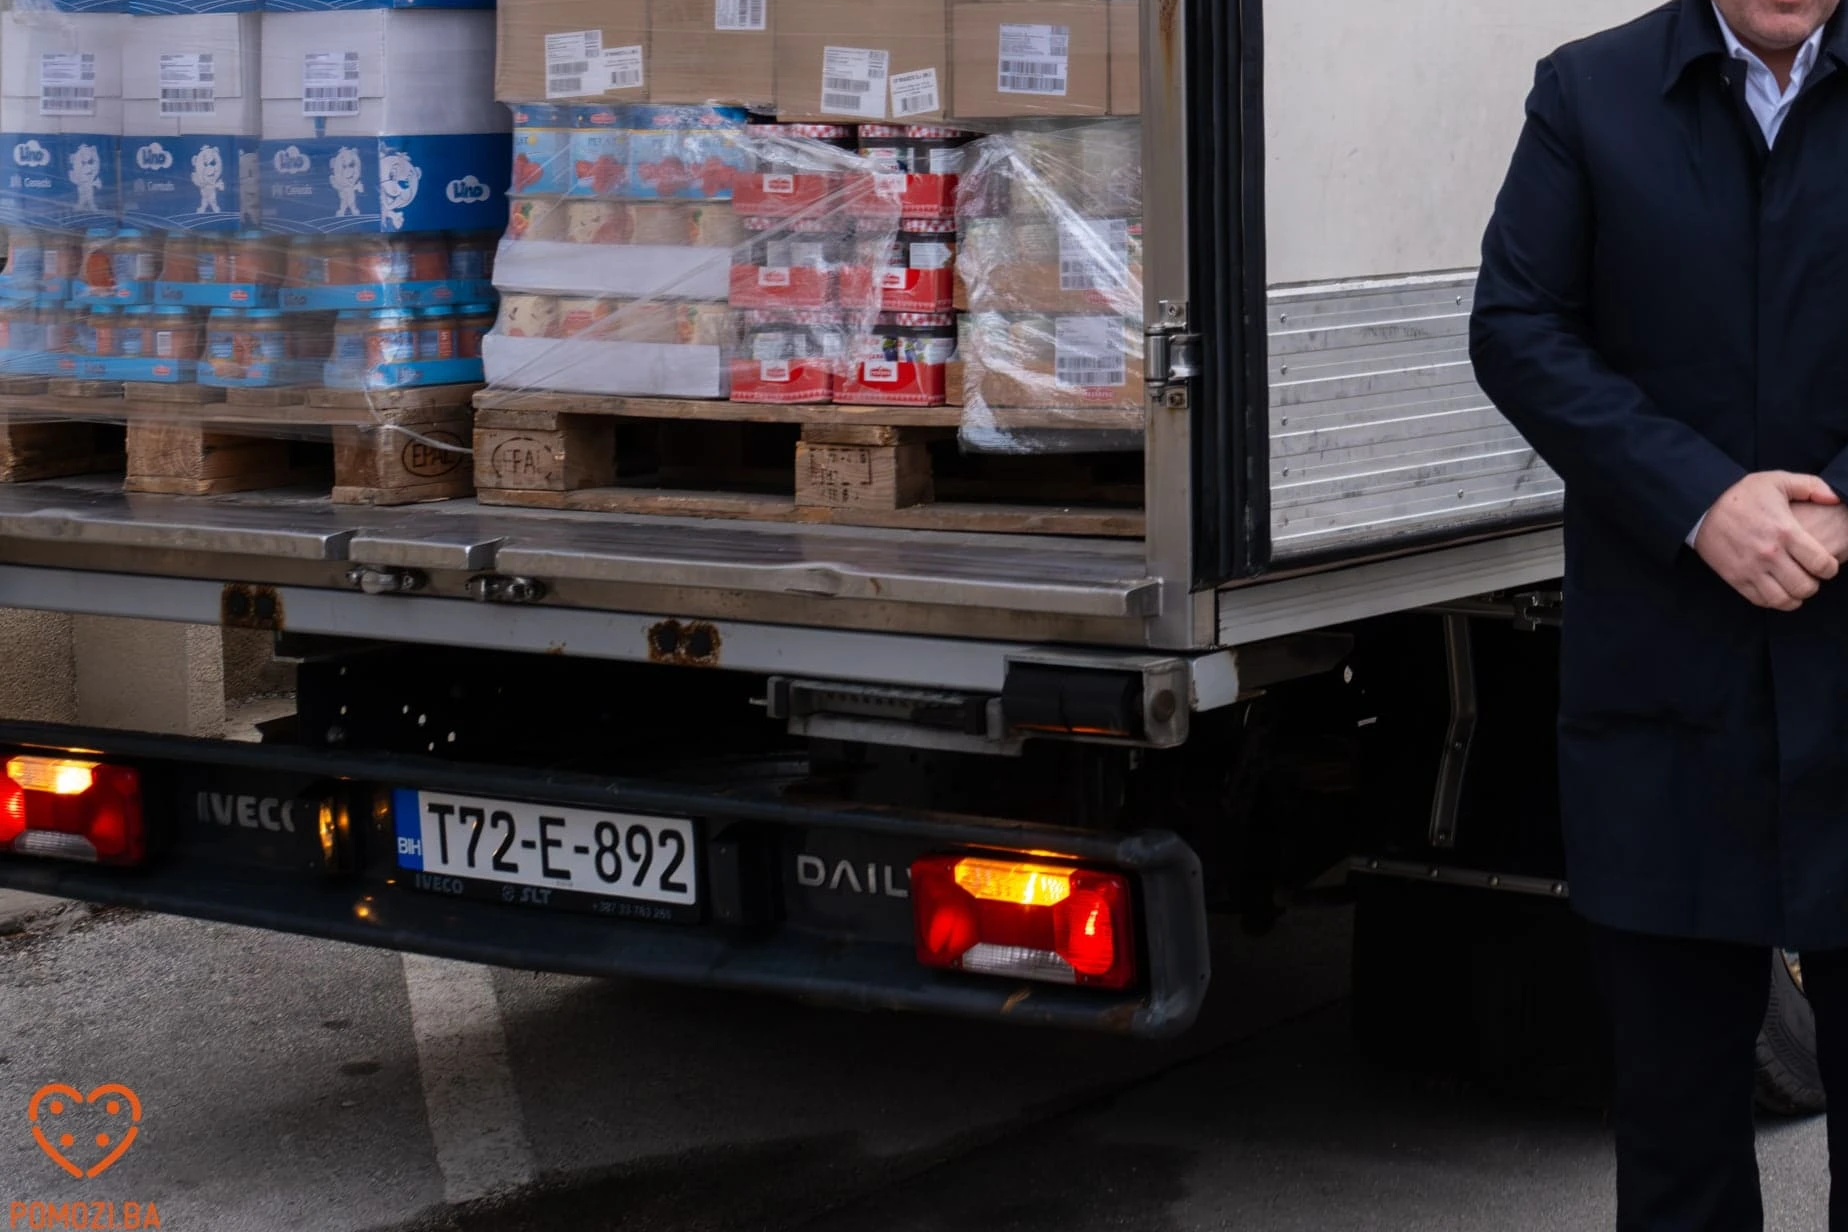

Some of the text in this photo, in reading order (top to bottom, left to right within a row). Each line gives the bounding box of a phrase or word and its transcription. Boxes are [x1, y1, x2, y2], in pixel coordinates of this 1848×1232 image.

[453, 182, 483, 199] Lino
[397, 836, 422, 856] BIH
[427, 802, 688, 894] T72-E-892
[415, 873, 464, 895] IVECO
[797, 854, 912, 898] DAIL
[519, 886, 551, 905] SLT
